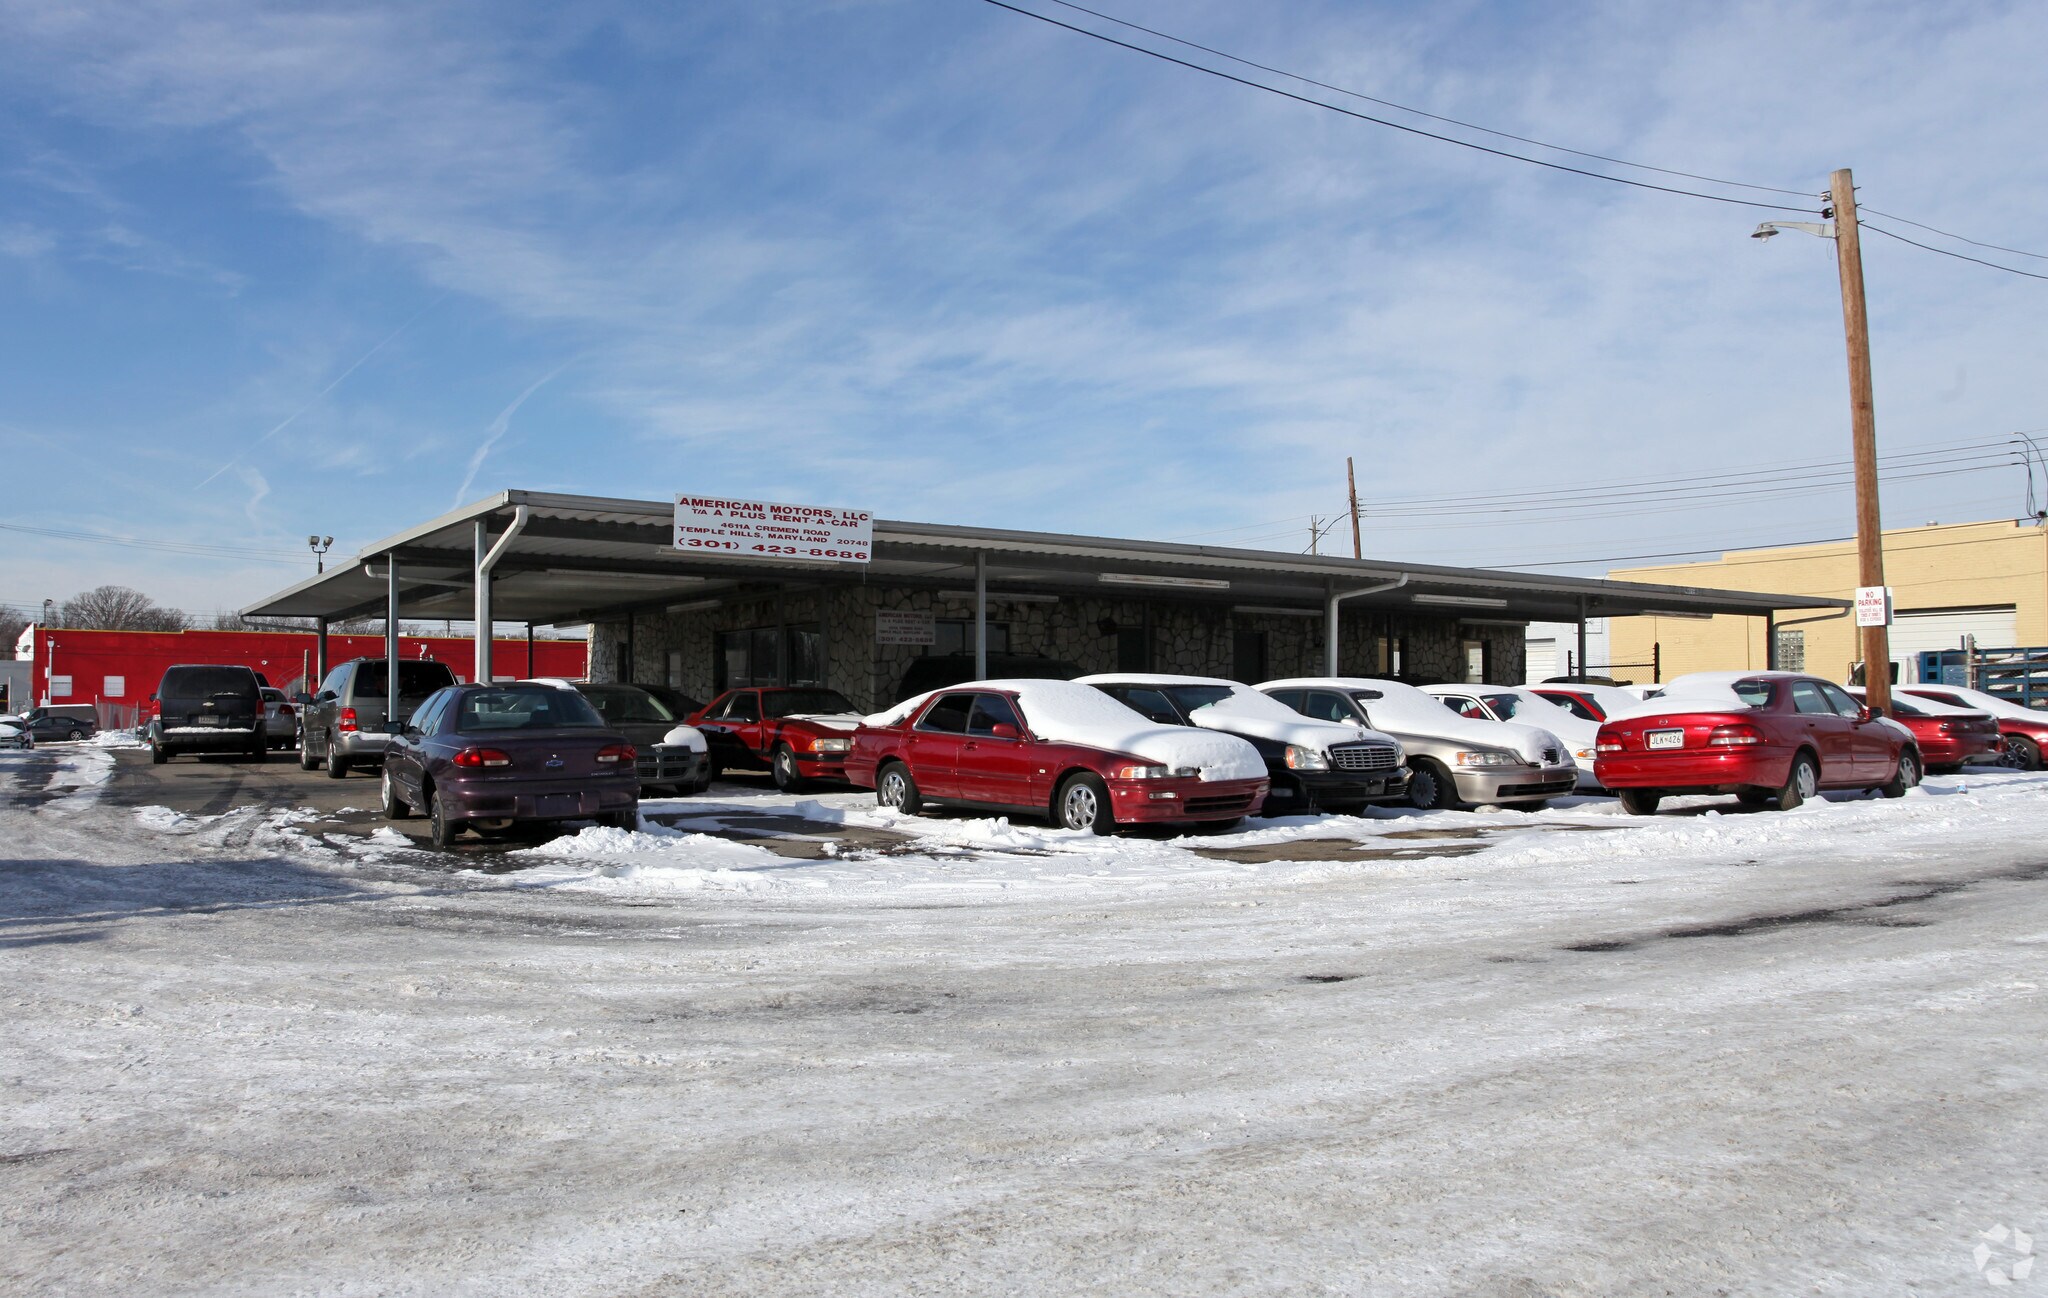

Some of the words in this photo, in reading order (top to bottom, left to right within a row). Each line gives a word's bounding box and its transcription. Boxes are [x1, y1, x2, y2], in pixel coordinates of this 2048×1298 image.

[679, 497, 763, 512] AMERICAN
[770, 505, 836, 519] MOTORS,
[843, 511, 869, 522] LLC
[691, 508, 707, 516] T/A
[713, 509, 723, 517] A
[730, 510, 766, 521] PLUS
[773, 514, 858, 528] RENT-A-CAR
[679, 526, 725, 535] TEMPLE
[729, 530, 764, 539] HILLS,
[768, 533, 828, 543] MARYLAND
[837, 538, 868, 547] 20748
[720, 522, 750, 530] 4611A
[755, 525, 799, 535] CREMEN
[803, 528, 831, 537] ROAD
[678, 537, 740, 550] (301)
[751, 544, 868, 560] 423-8686
[1858, 598, 1882, 606] PARKING
[1651, 736, 1664, 744] JLK
[1668, 736, 1681, 744] 426
